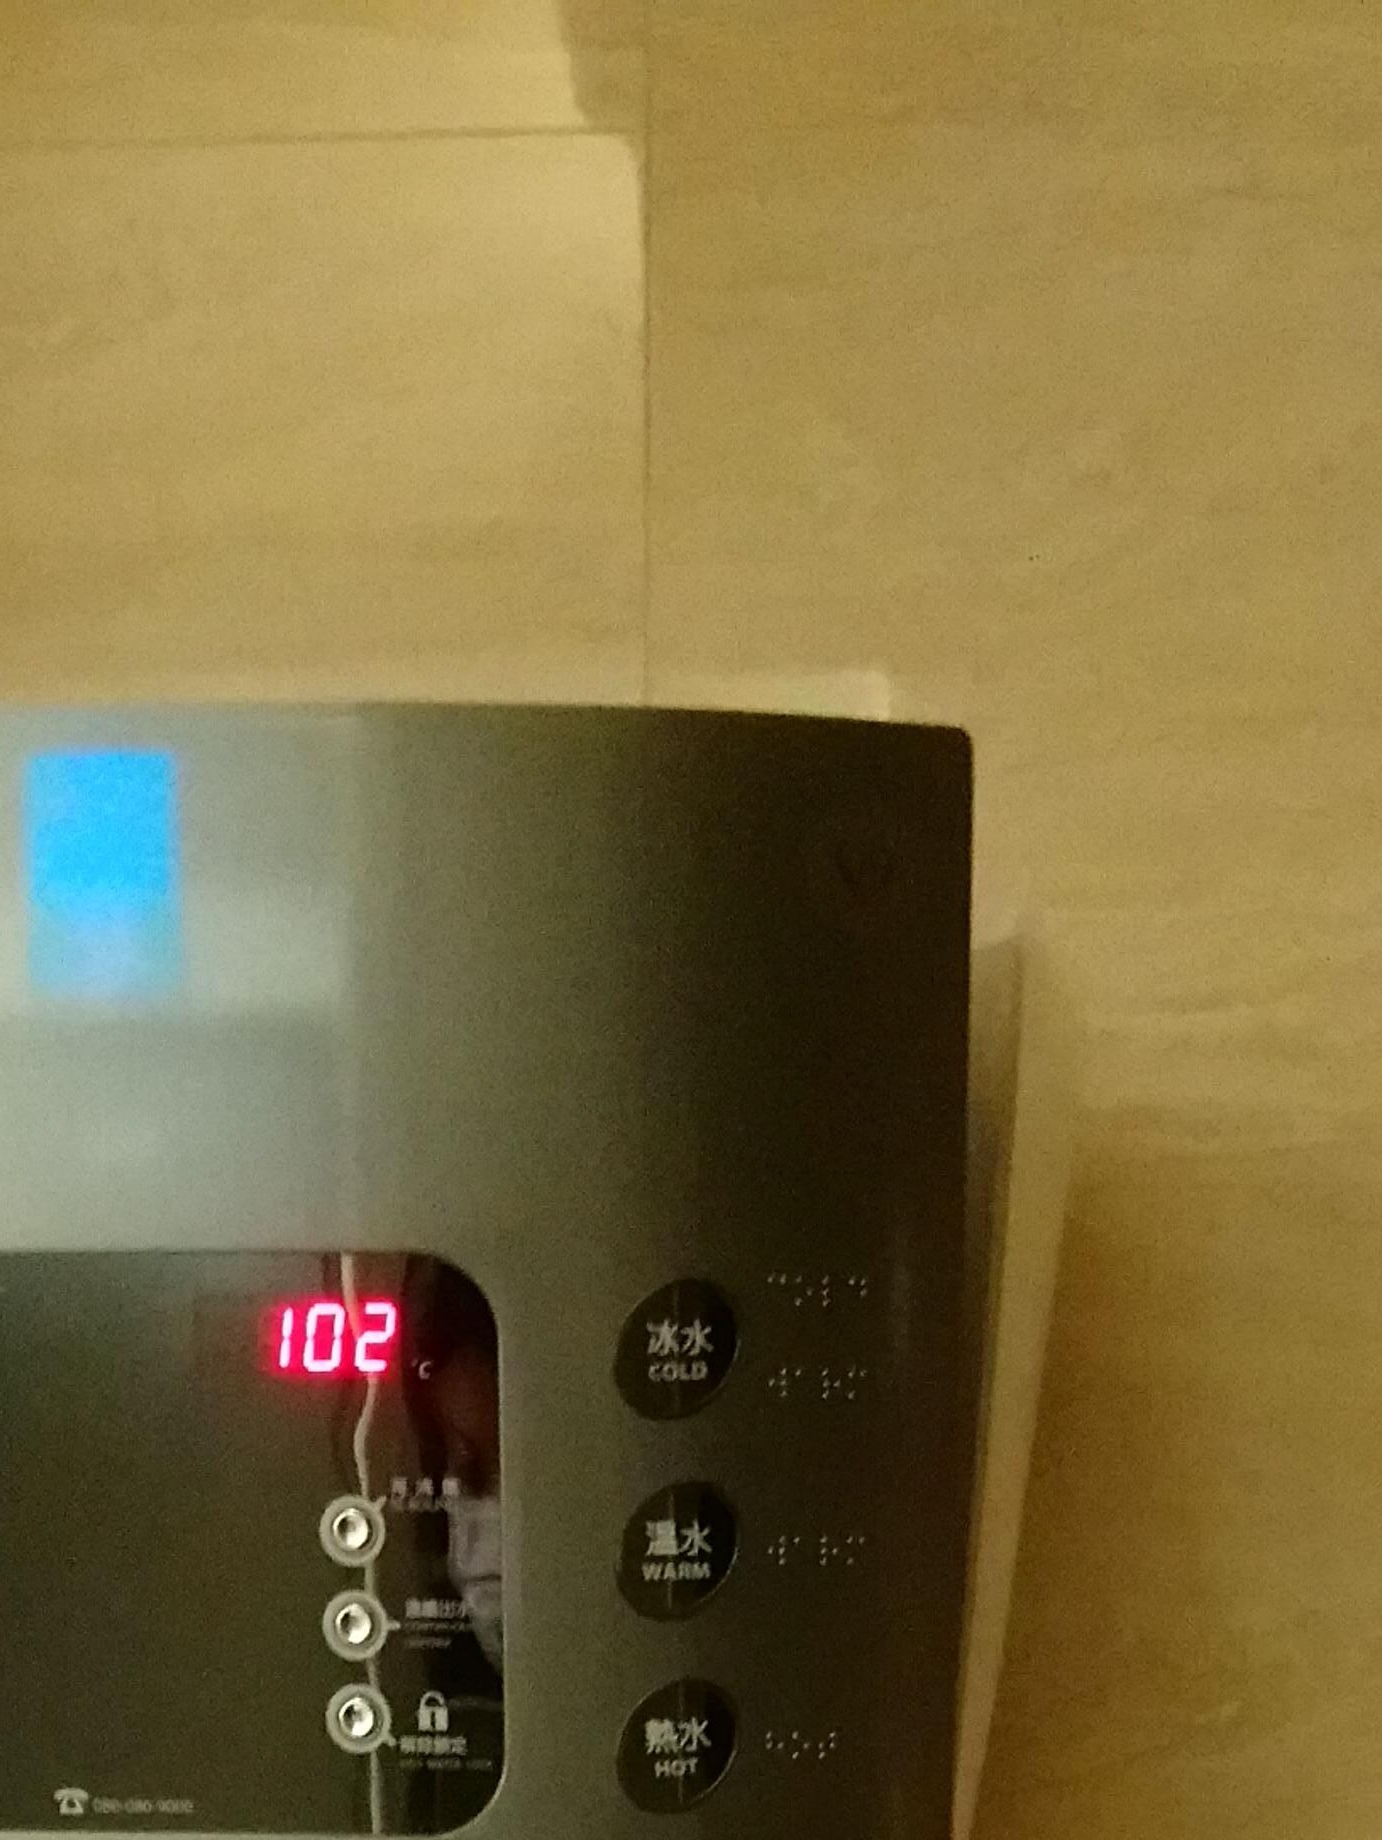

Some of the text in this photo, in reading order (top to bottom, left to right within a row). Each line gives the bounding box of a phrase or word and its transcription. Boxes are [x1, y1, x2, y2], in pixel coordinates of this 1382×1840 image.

[279, 1302, 396, 1372] 102
[647, 1318, 714, 1357] 冰水
[648, 1361, 708, 1383] COLD
[642, 1560, 711, 1582] WARM
[645, 1717, 712, 1754] 熱水
[654, 1757, 699, 1779] HOT
